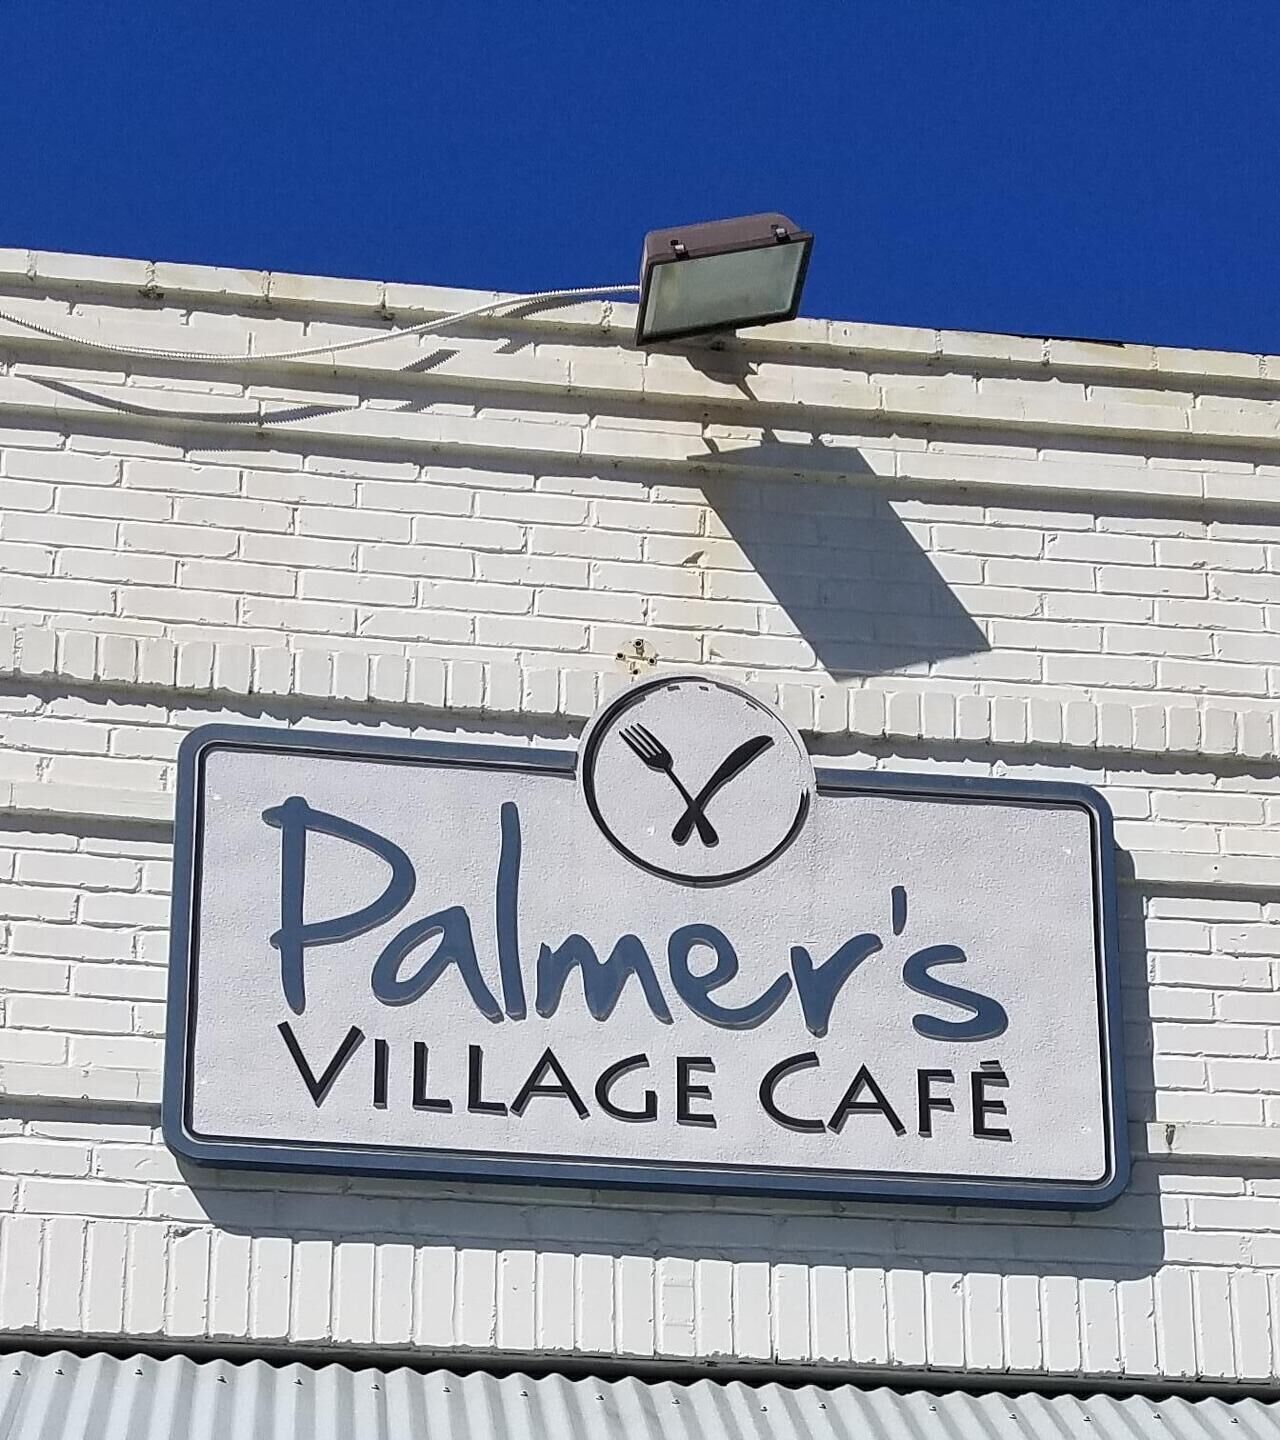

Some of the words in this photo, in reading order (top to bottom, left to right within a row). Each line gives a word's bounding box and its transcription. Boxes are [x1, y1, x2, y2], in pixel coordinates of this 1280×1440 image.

[262, 796, 1008, 1041] Palmer's
[277, 1021, 718, 1127] VILLAGE
[759, 1051, 1012, 1142] CAFÉ
